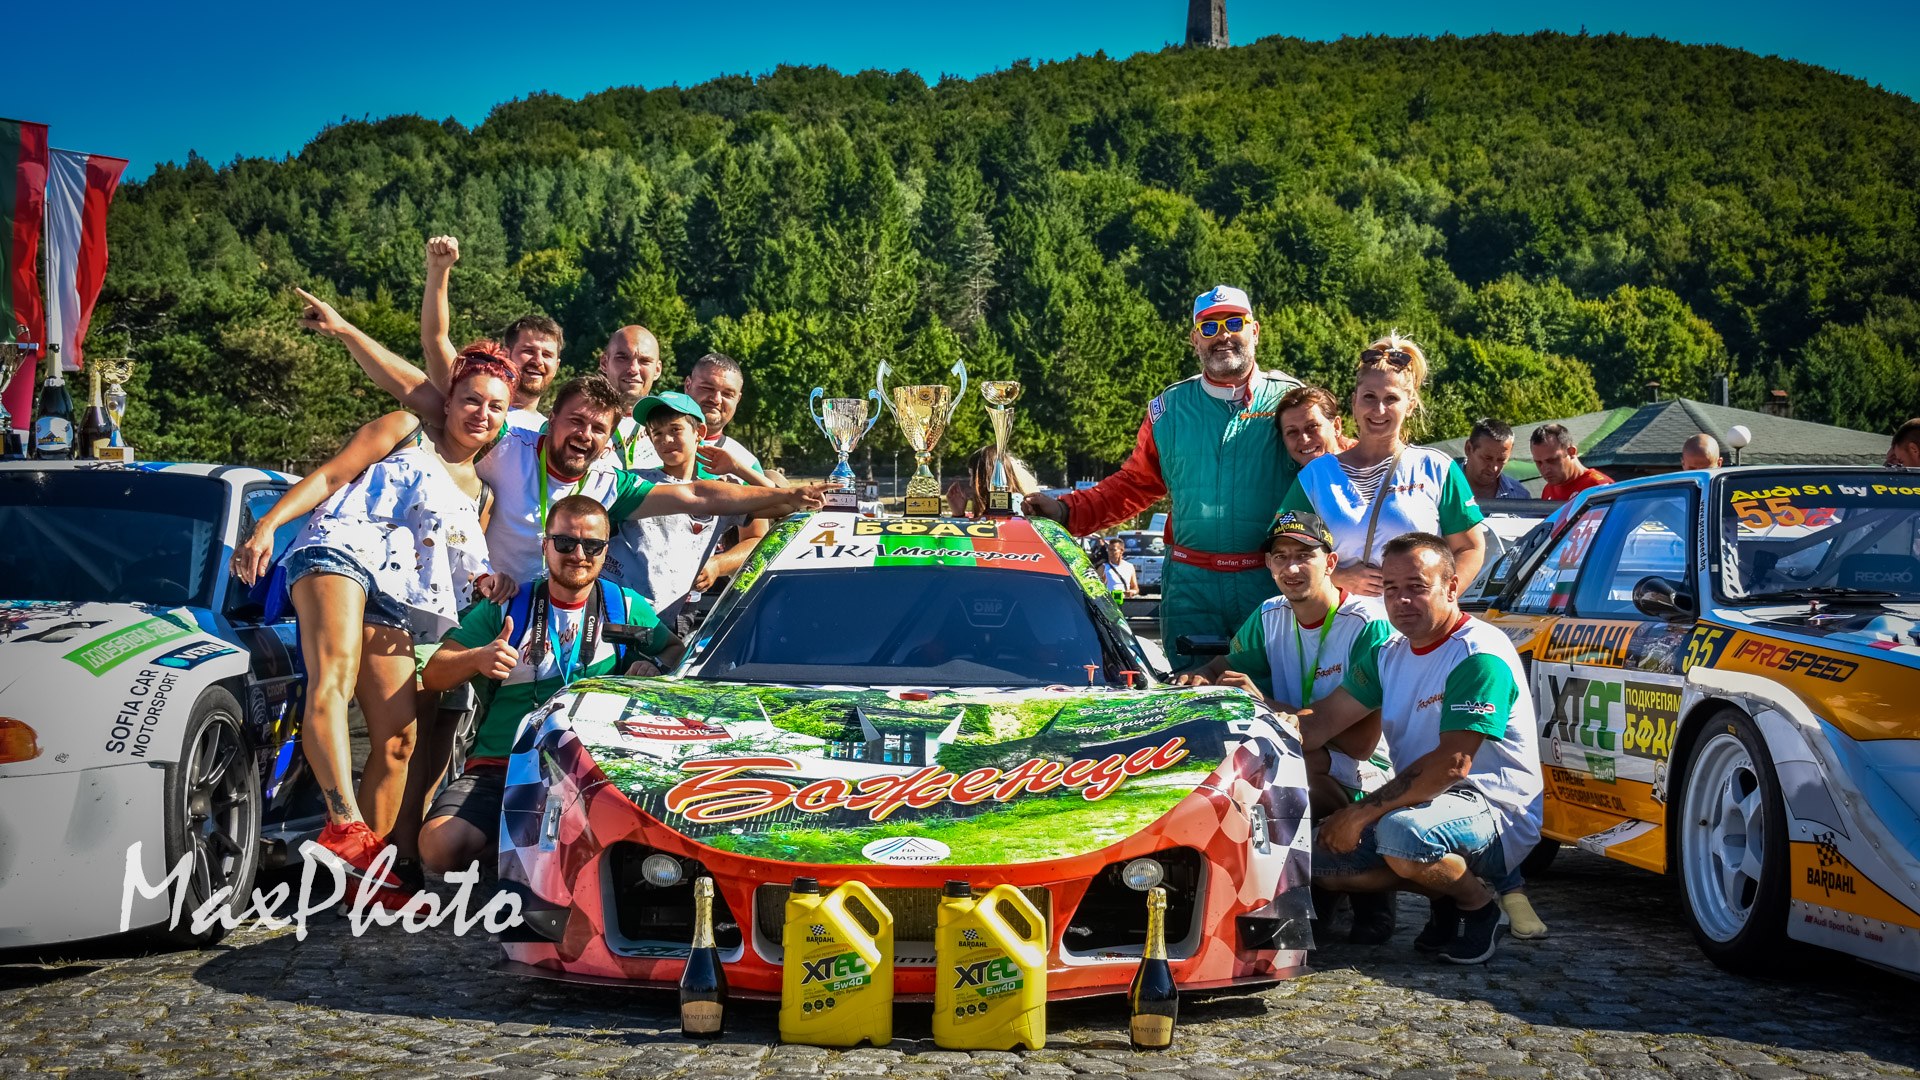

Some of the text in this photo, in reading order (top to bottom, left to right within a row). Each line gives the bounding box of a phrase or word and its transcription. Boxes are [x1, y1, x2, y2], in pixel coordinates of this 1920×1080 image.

[1730, 486, 1800, 503] Audi
[1802, 485, 1832, 495] S1
[1838, 484, 1867, 497] by
[1732, 498, 1805, 528] 55
[809, 530, 838, 547] 4
[855, 522, 995, 537] БФАС
[796, 544, 1044, 563] ARA Motorsport
[1855, 569, 1912, 583] RECARO
[974, 602, 1002, 614] OMP
[535, 616, 544, 643] DIGITAL
[586, 615, 596, 642] Canon
[80, 629, 155, 668] MISSION
[1545, 624, 1629, 666] BARDAHL
[1682, 627, 1724, 673] 55
[106, 669, 158, 754] SOFIA CAR
[131, 672, 179, 758] MOTORSPORT
[665, 736, 1189, 824] Боженци
[1551, 769, 1586, 787] EXTREME
[1557, 786, 1627, 811] PERFORMANCE OIL
[1806, 868, 1857, 895] BARDAHL
[1813, 917, 1828, 927] Audi
[1829, 920, 1846, 932] Sport
[806, 936, 835, 944] BARDAHL
[958, 940, 988, 949] BARDAHL
[801, 952, 866, 985] XTEC
[953, 956, 1018, 990] XTEC
